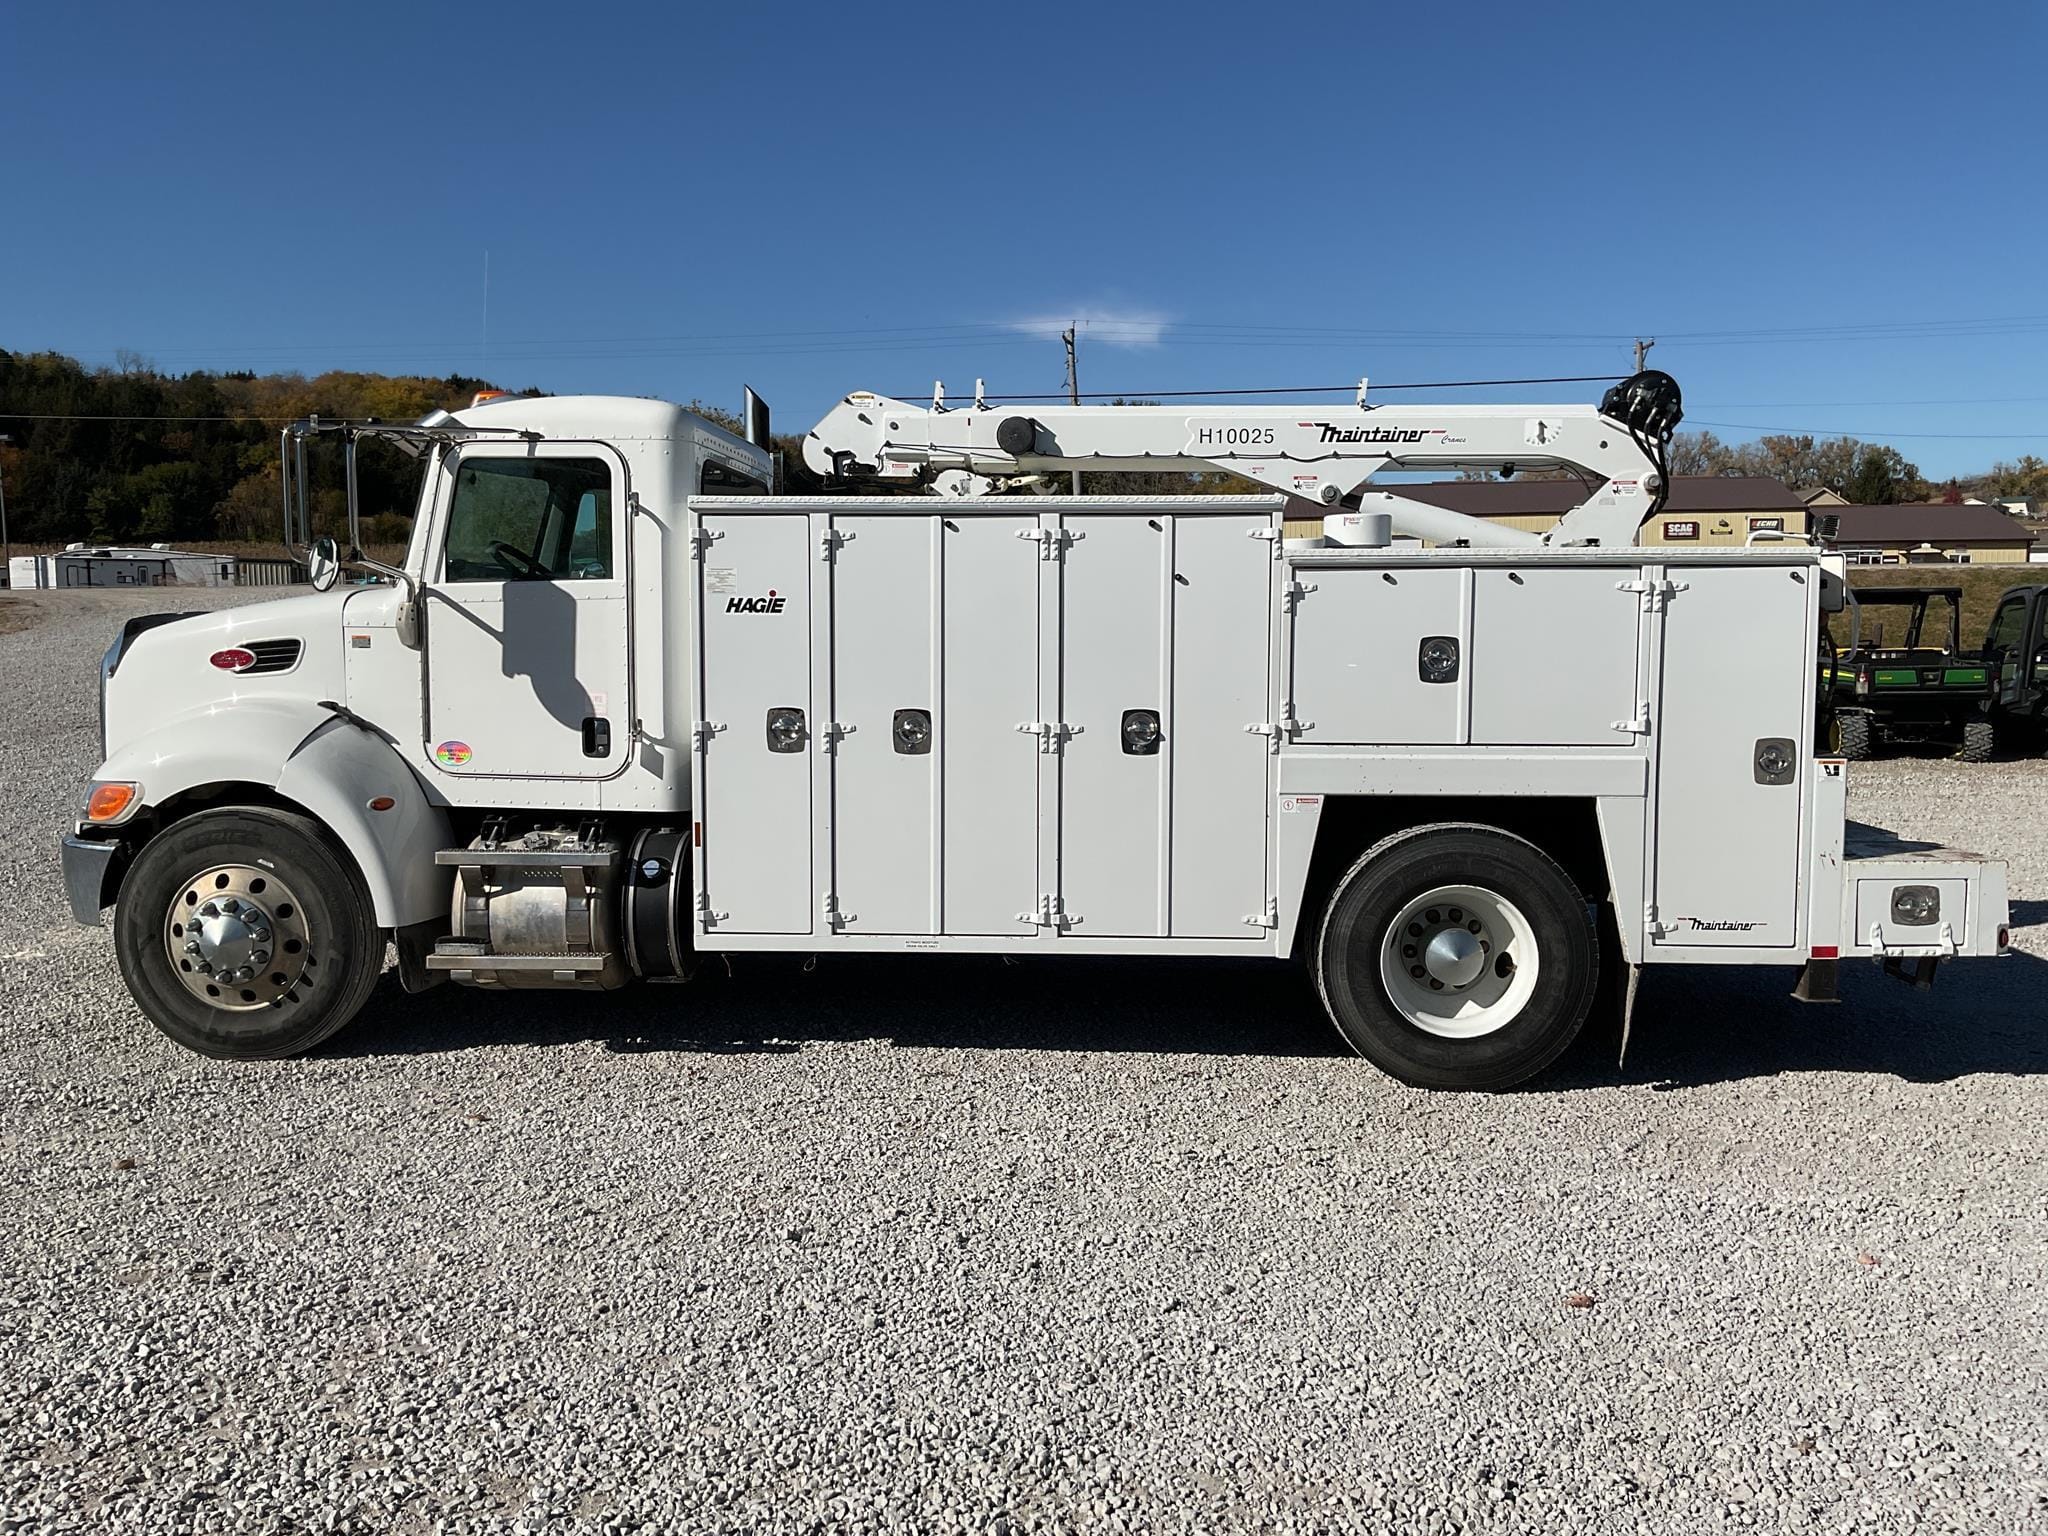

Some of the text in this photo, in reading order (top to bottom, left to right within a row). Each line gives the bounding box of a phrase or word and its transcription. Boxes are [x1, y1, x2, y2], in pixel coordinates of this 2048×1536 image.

[1199, 428, 1275, 444] H10025
[1313, 422, 1431, 443] Maintainer
[1667, 523, 1693, 533] SCAG
[1687, 917, 1758, 931] Maintainer
